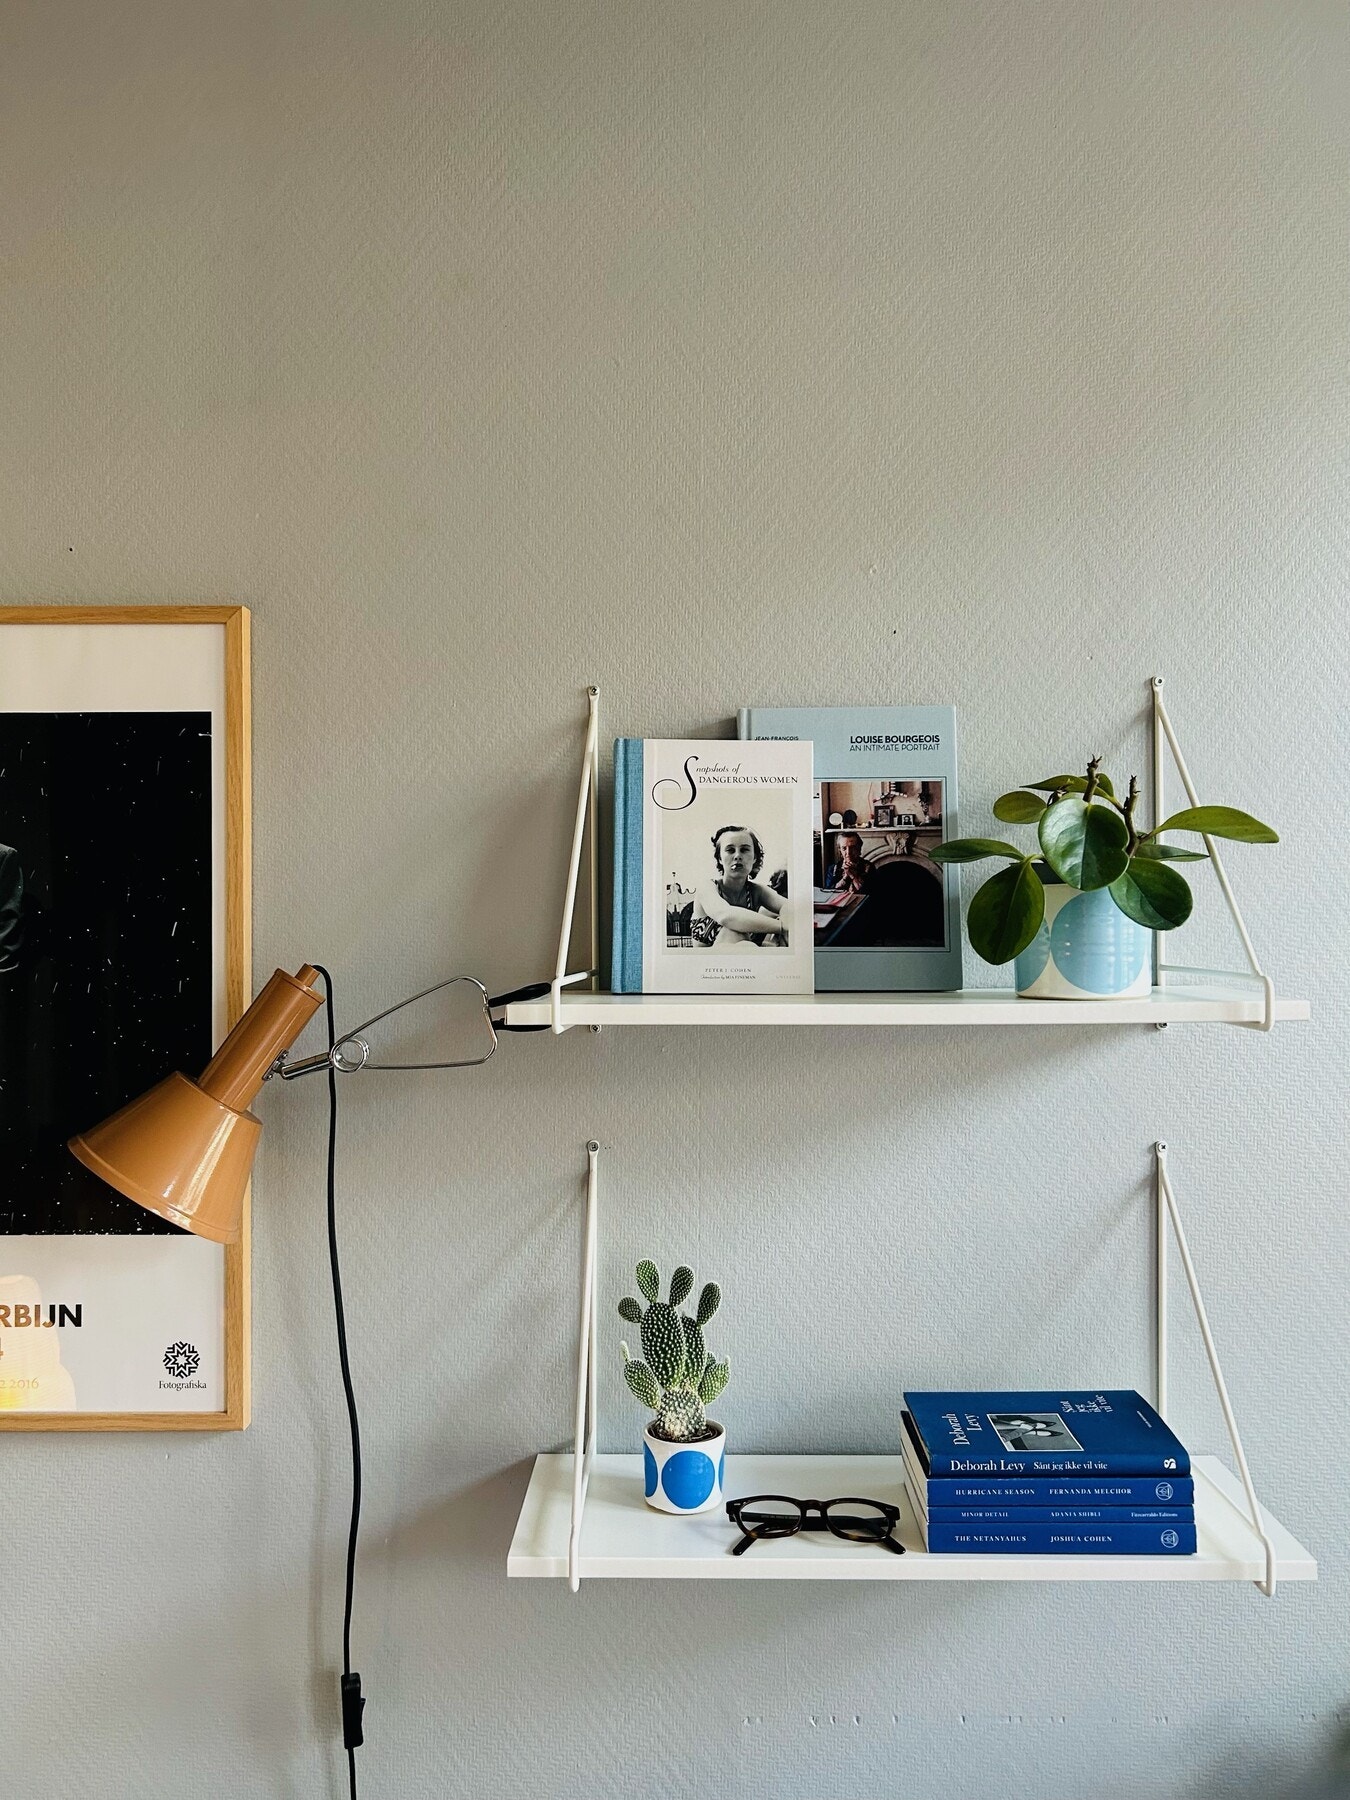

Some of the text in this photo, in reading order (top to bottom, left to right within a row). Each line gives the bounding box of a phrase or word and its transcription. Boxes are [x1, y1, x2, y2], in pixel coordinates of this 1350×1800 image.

[850, 734, 941, 744] LOUISE BOURGEOIS
[849, 743, 940, 752] AN INTIMATE PORTRAIT
[731, 763, 742, 775] of
[699, 776, 799, 784] DANGEROUS WOMEN
[0, 1304, 82, 1328] RBIJN
[10, 1377, 40, 1389] 2016
[159, 1380, 207, 1392] Fotografiska
[964, 1413, 983, 1431] Levy
[941, 1413, 970, 1445] Deborah
[950, 1460, 1108, 1473] Deborah Levy Sånt jeg ikke vil vite
